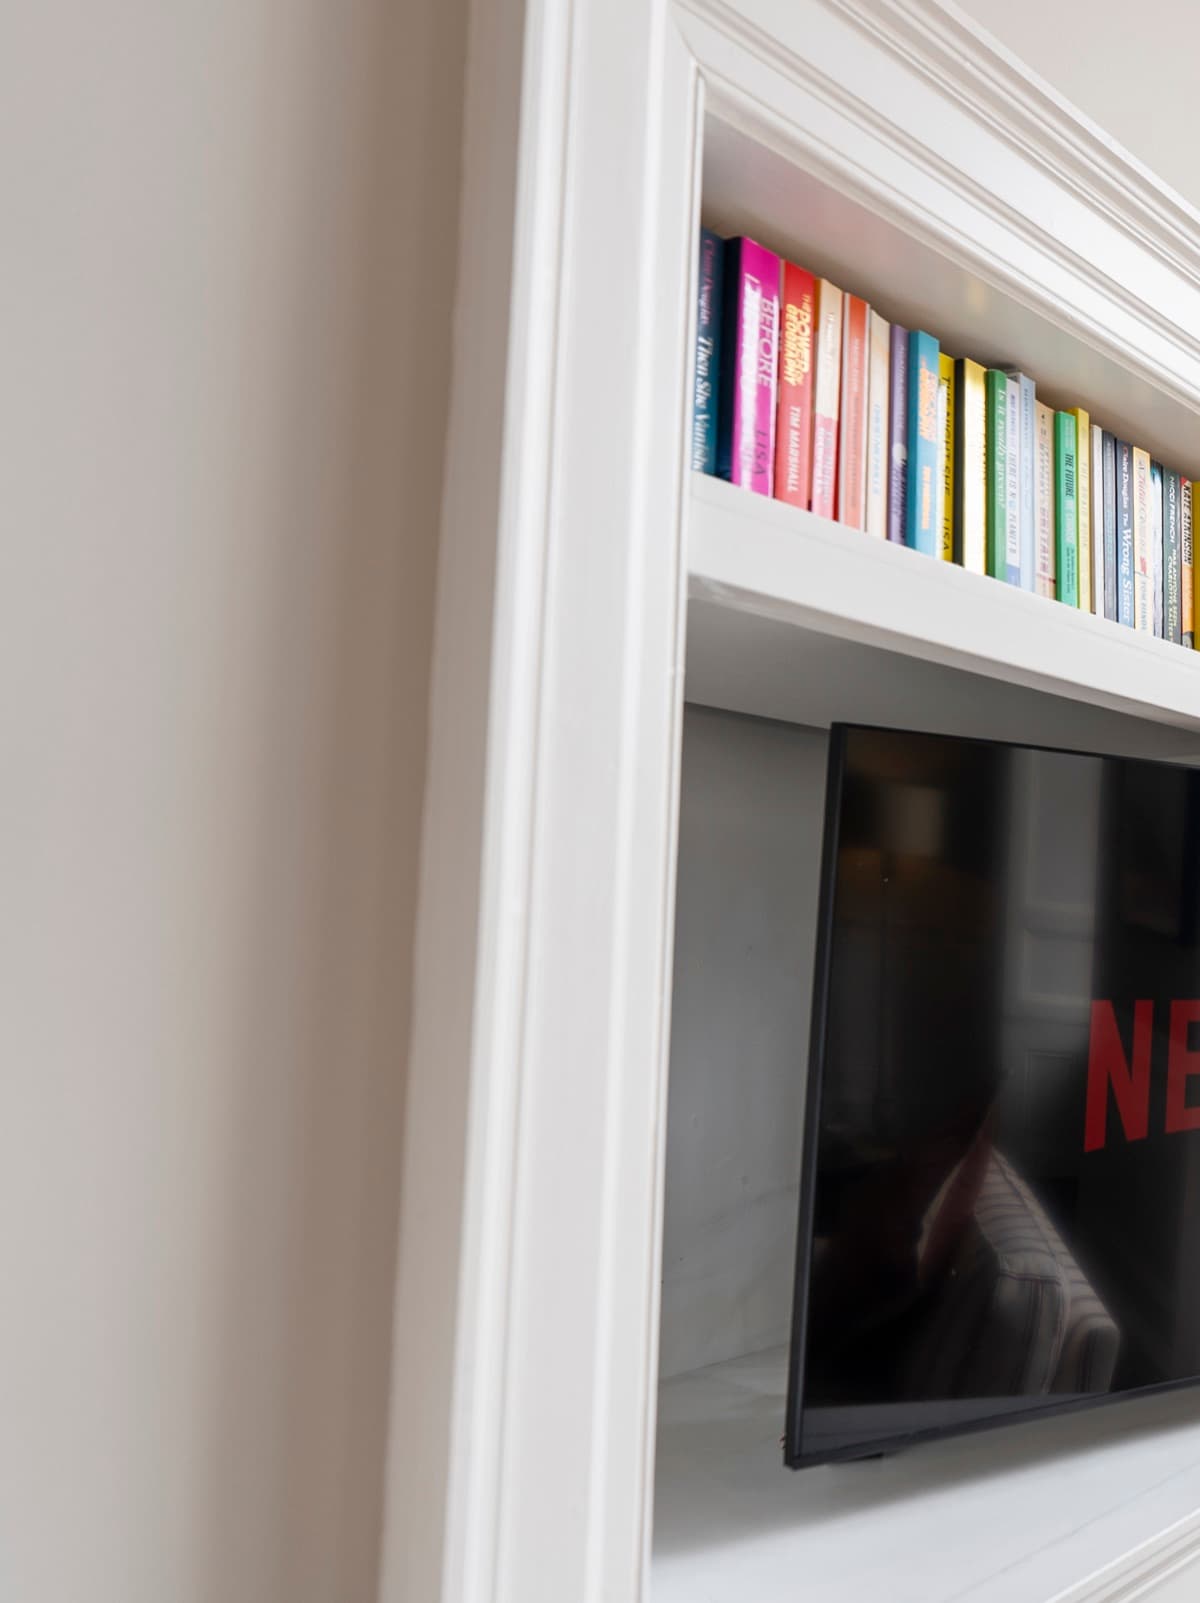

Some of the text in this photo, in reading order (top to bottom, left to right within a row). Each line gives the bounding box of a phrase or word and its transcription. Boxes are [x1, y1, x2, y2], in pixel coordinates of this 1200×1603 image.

[697, 336, 714, 377] Then
[758, 298, 774, 387] BEFORE
[784, 303, 798, 386] GEOGRAPHY
[796, 309, 810, 373] POWER
[695, 378, 712, 409] She
[998, 389, 1008, 401] Is
[998, 405, 1005, 415] it
[754, 429, 769, 476] LISA
[787, 405, 800, 492] TIM MARSHALL
[996, 420, 1007, 457] really
[1064, 453, 1074, 468] THE
[1009, 480, 1016, 489] IS
[1065, 469, 1074, 498] FUTURE
[1121, 528, 1131, 574] Wrong
[1184, 513, 1192, 565] ATKINSON
[1122, 578, 1132, 623] Sister
